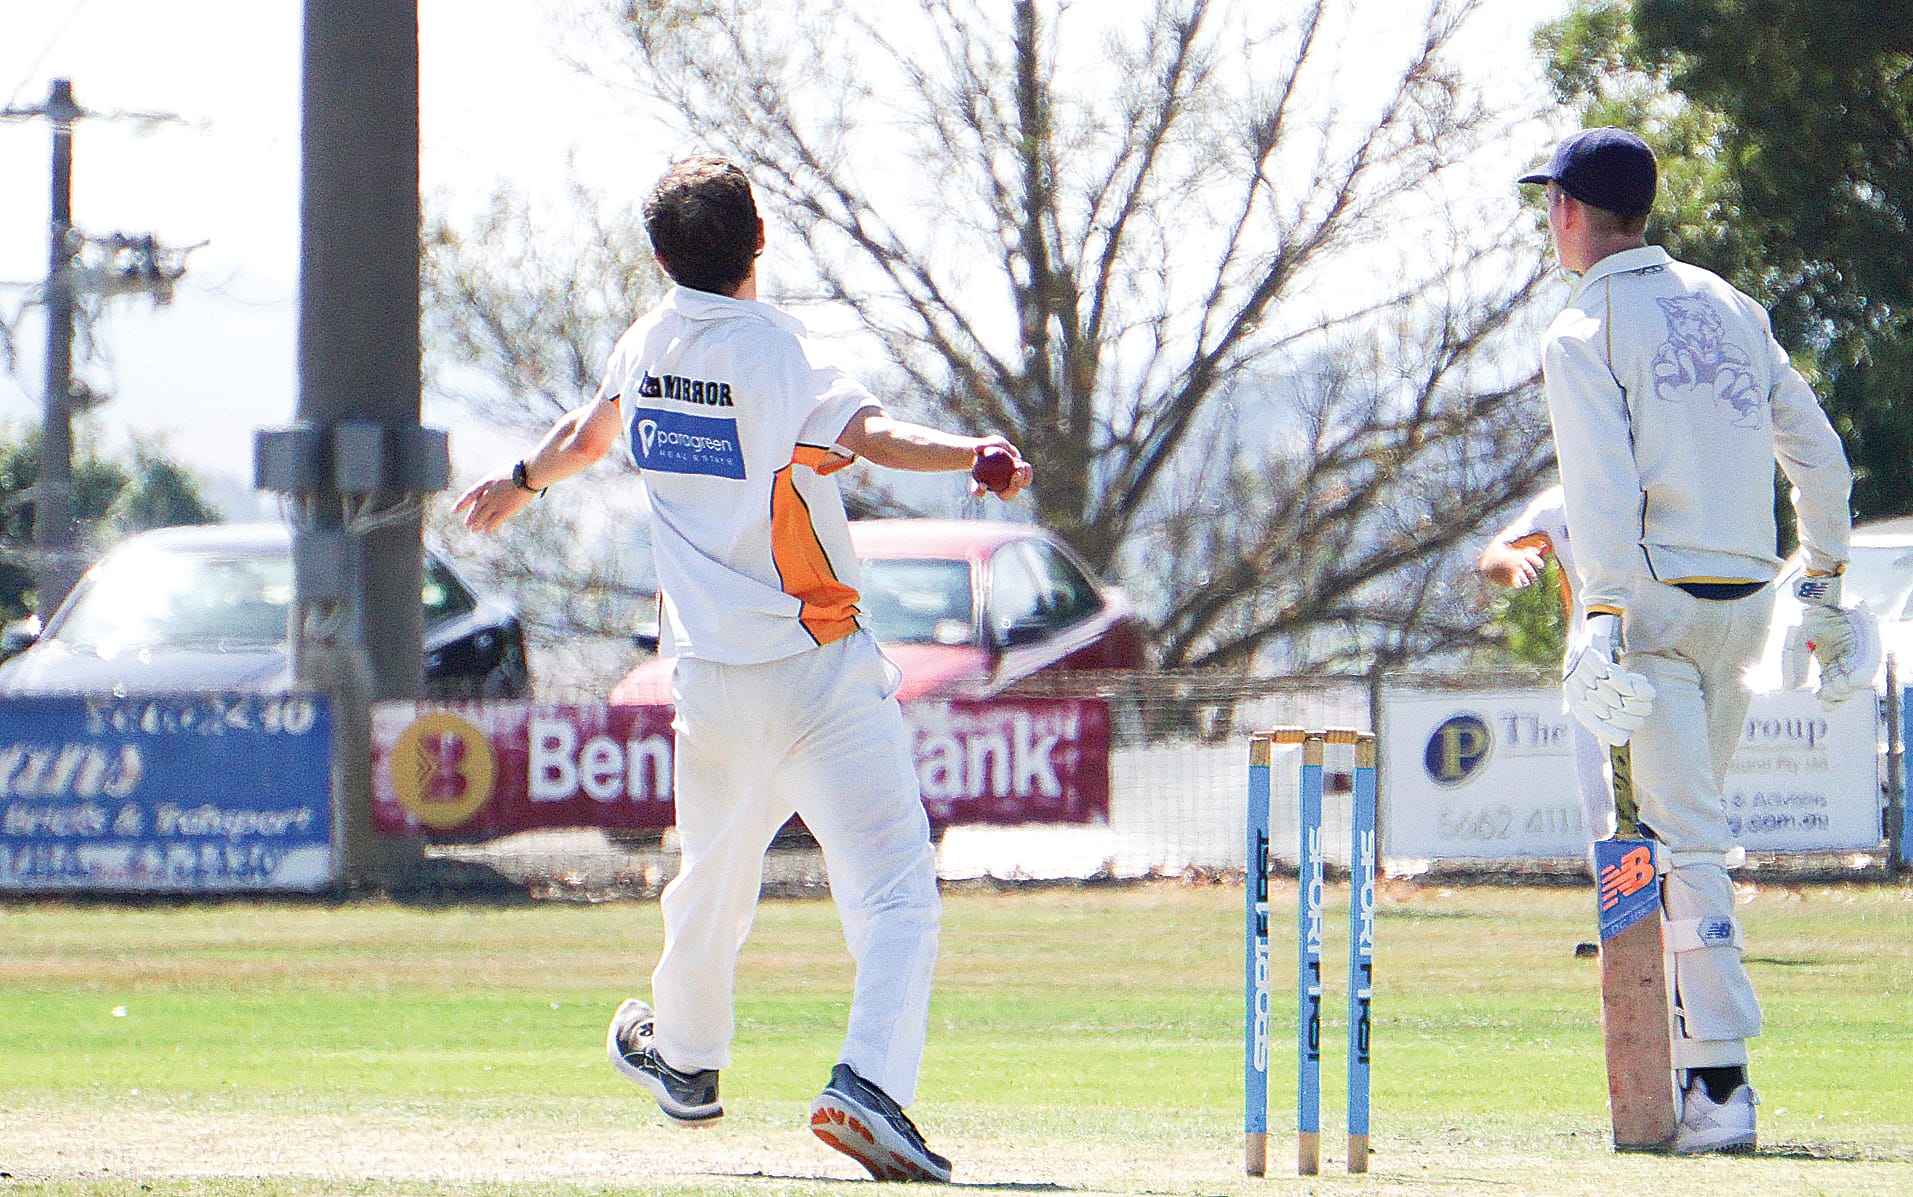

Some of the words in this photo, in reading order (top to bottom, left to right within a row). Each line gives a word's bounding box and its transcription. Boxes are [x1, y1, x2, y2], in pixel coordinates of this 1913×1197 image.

[657, 430, 733, 453] paragreen
[1747, 718, 1829, 749] roup
[527, 717, 673, 801] Ben
[919, 710, 1063, 799] ank
